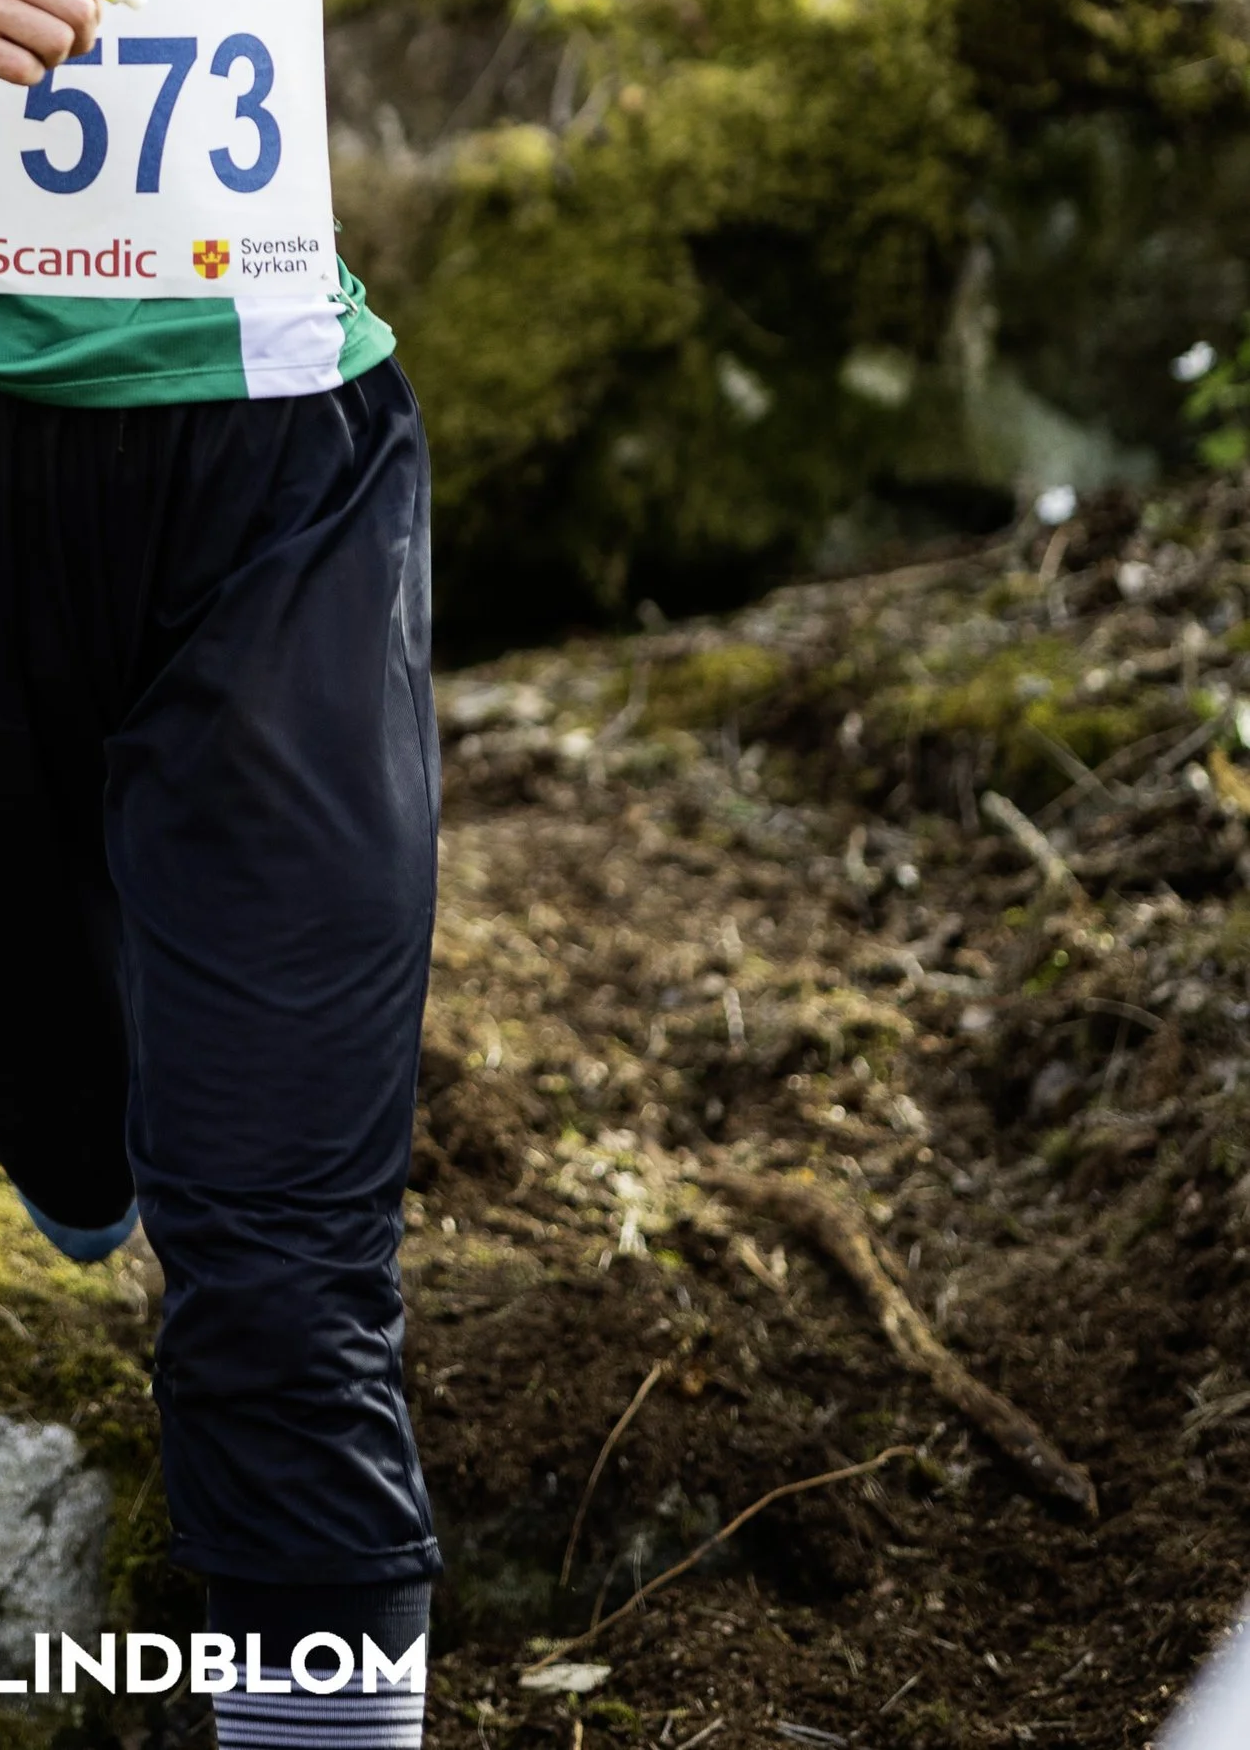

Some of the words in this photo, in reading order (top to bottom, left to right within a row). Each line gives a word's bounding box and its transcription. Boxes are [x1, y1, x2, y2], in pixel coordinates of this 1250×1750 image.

[20, 33, 282, 194] 573
[241, 236, 319, 254] Svenska
[241, 256, 308, 279] kyrkan
